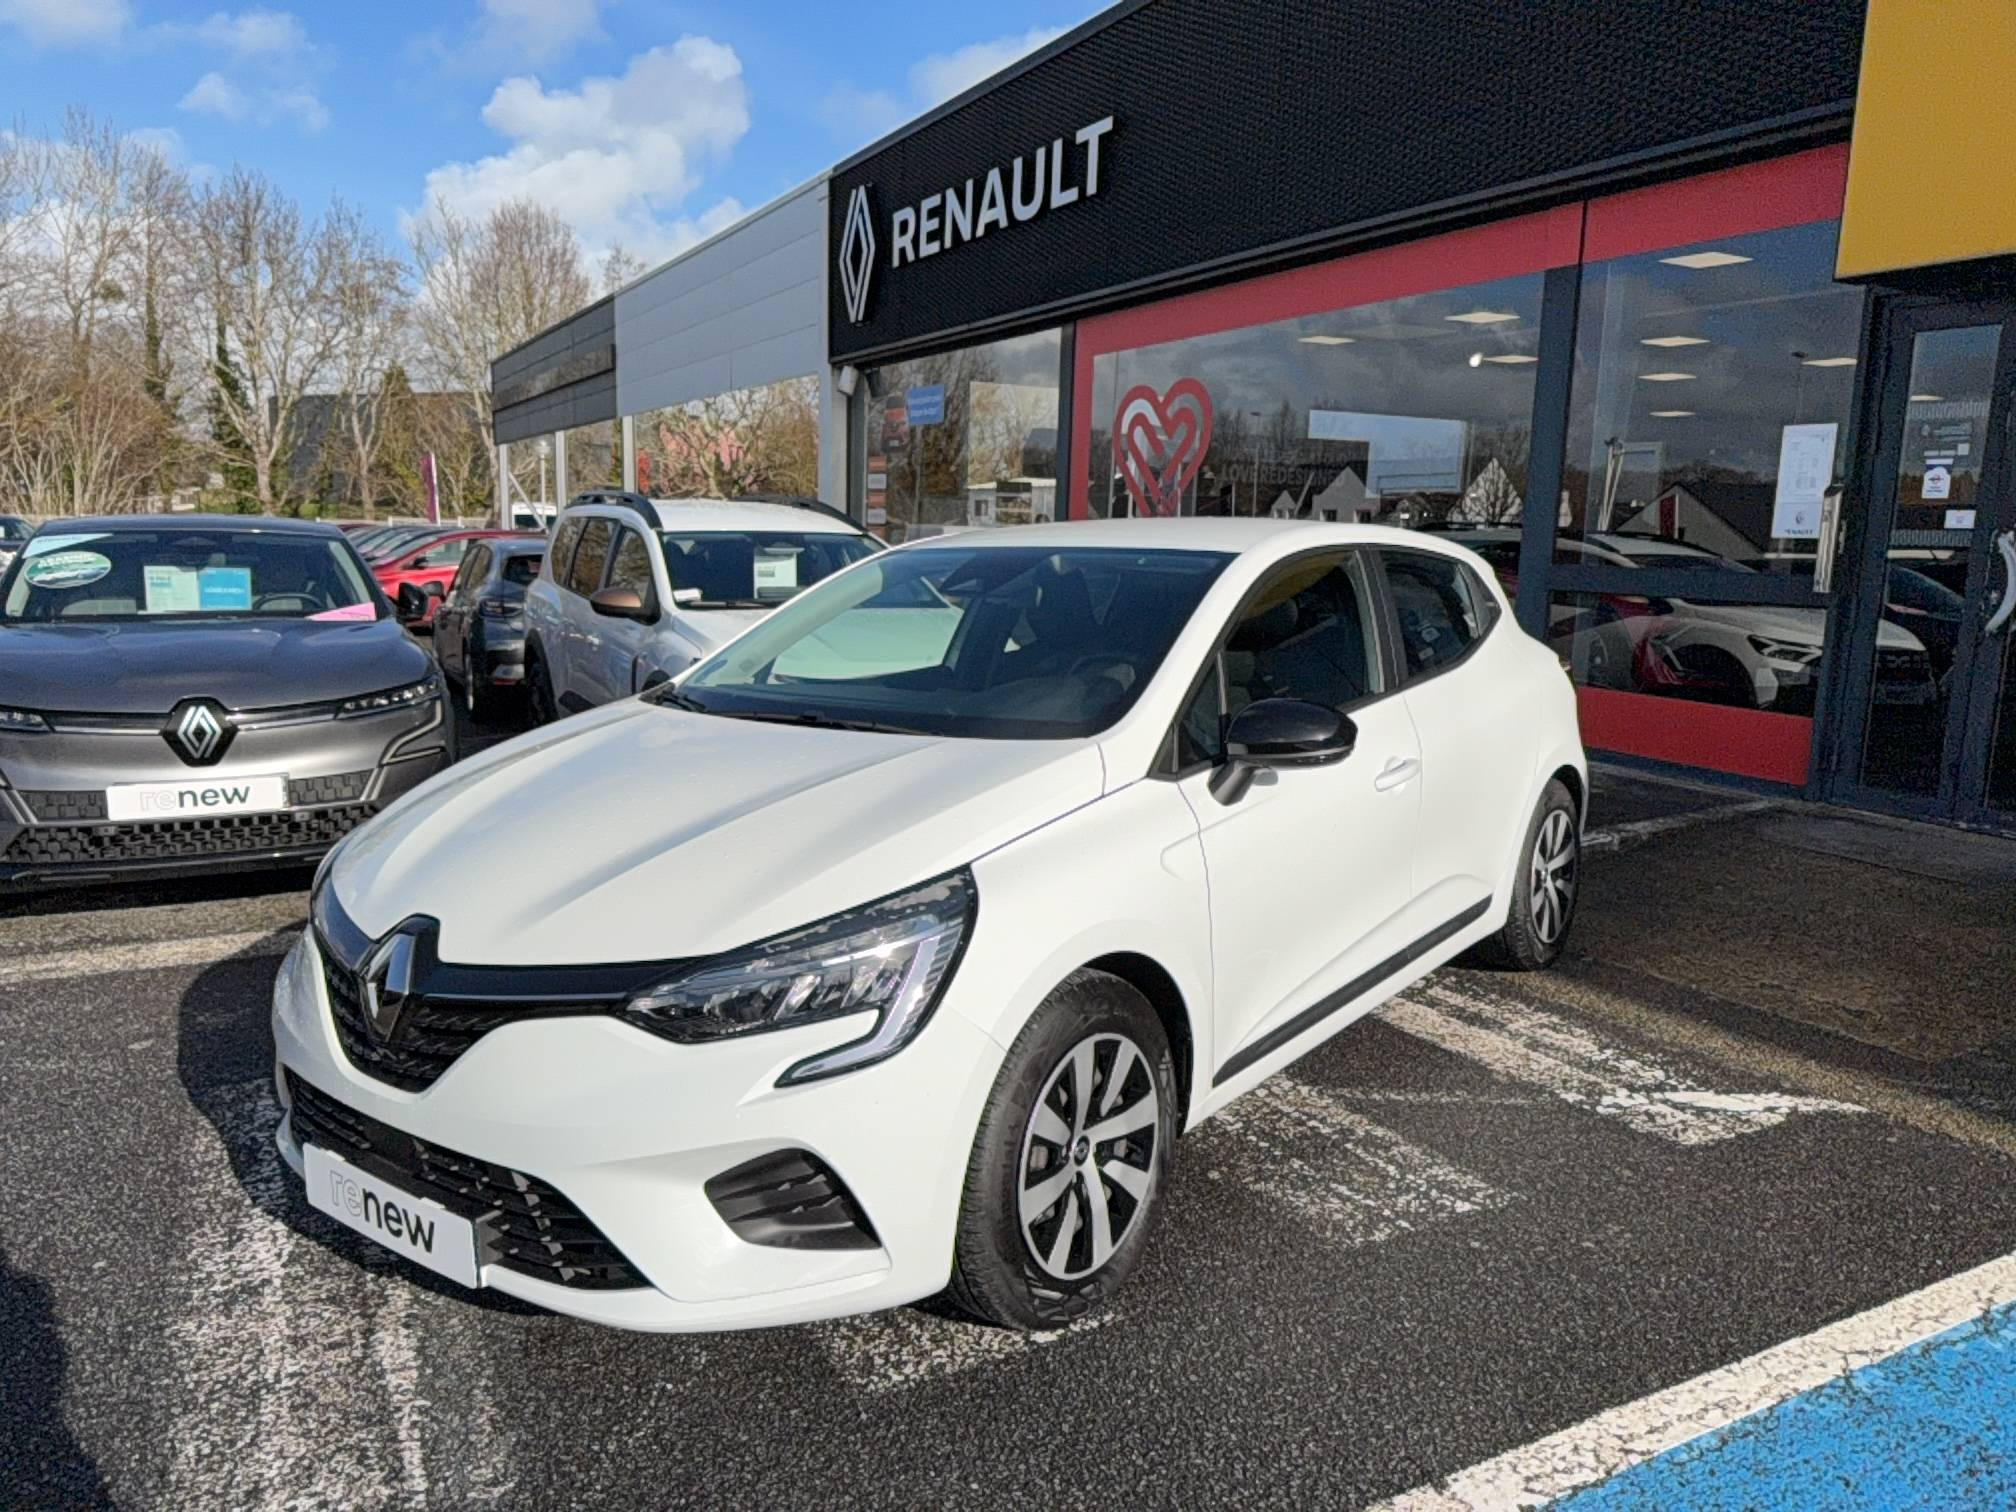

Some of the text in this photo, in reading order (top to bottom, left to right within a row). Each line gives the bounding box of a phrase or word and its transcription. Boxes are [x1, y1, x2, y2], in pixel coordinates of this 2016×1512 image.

[892, 115, 1114, 269] RENAULT
[139, 785, 251, 812] renew
[329, 1169, 436, 1254] renew
